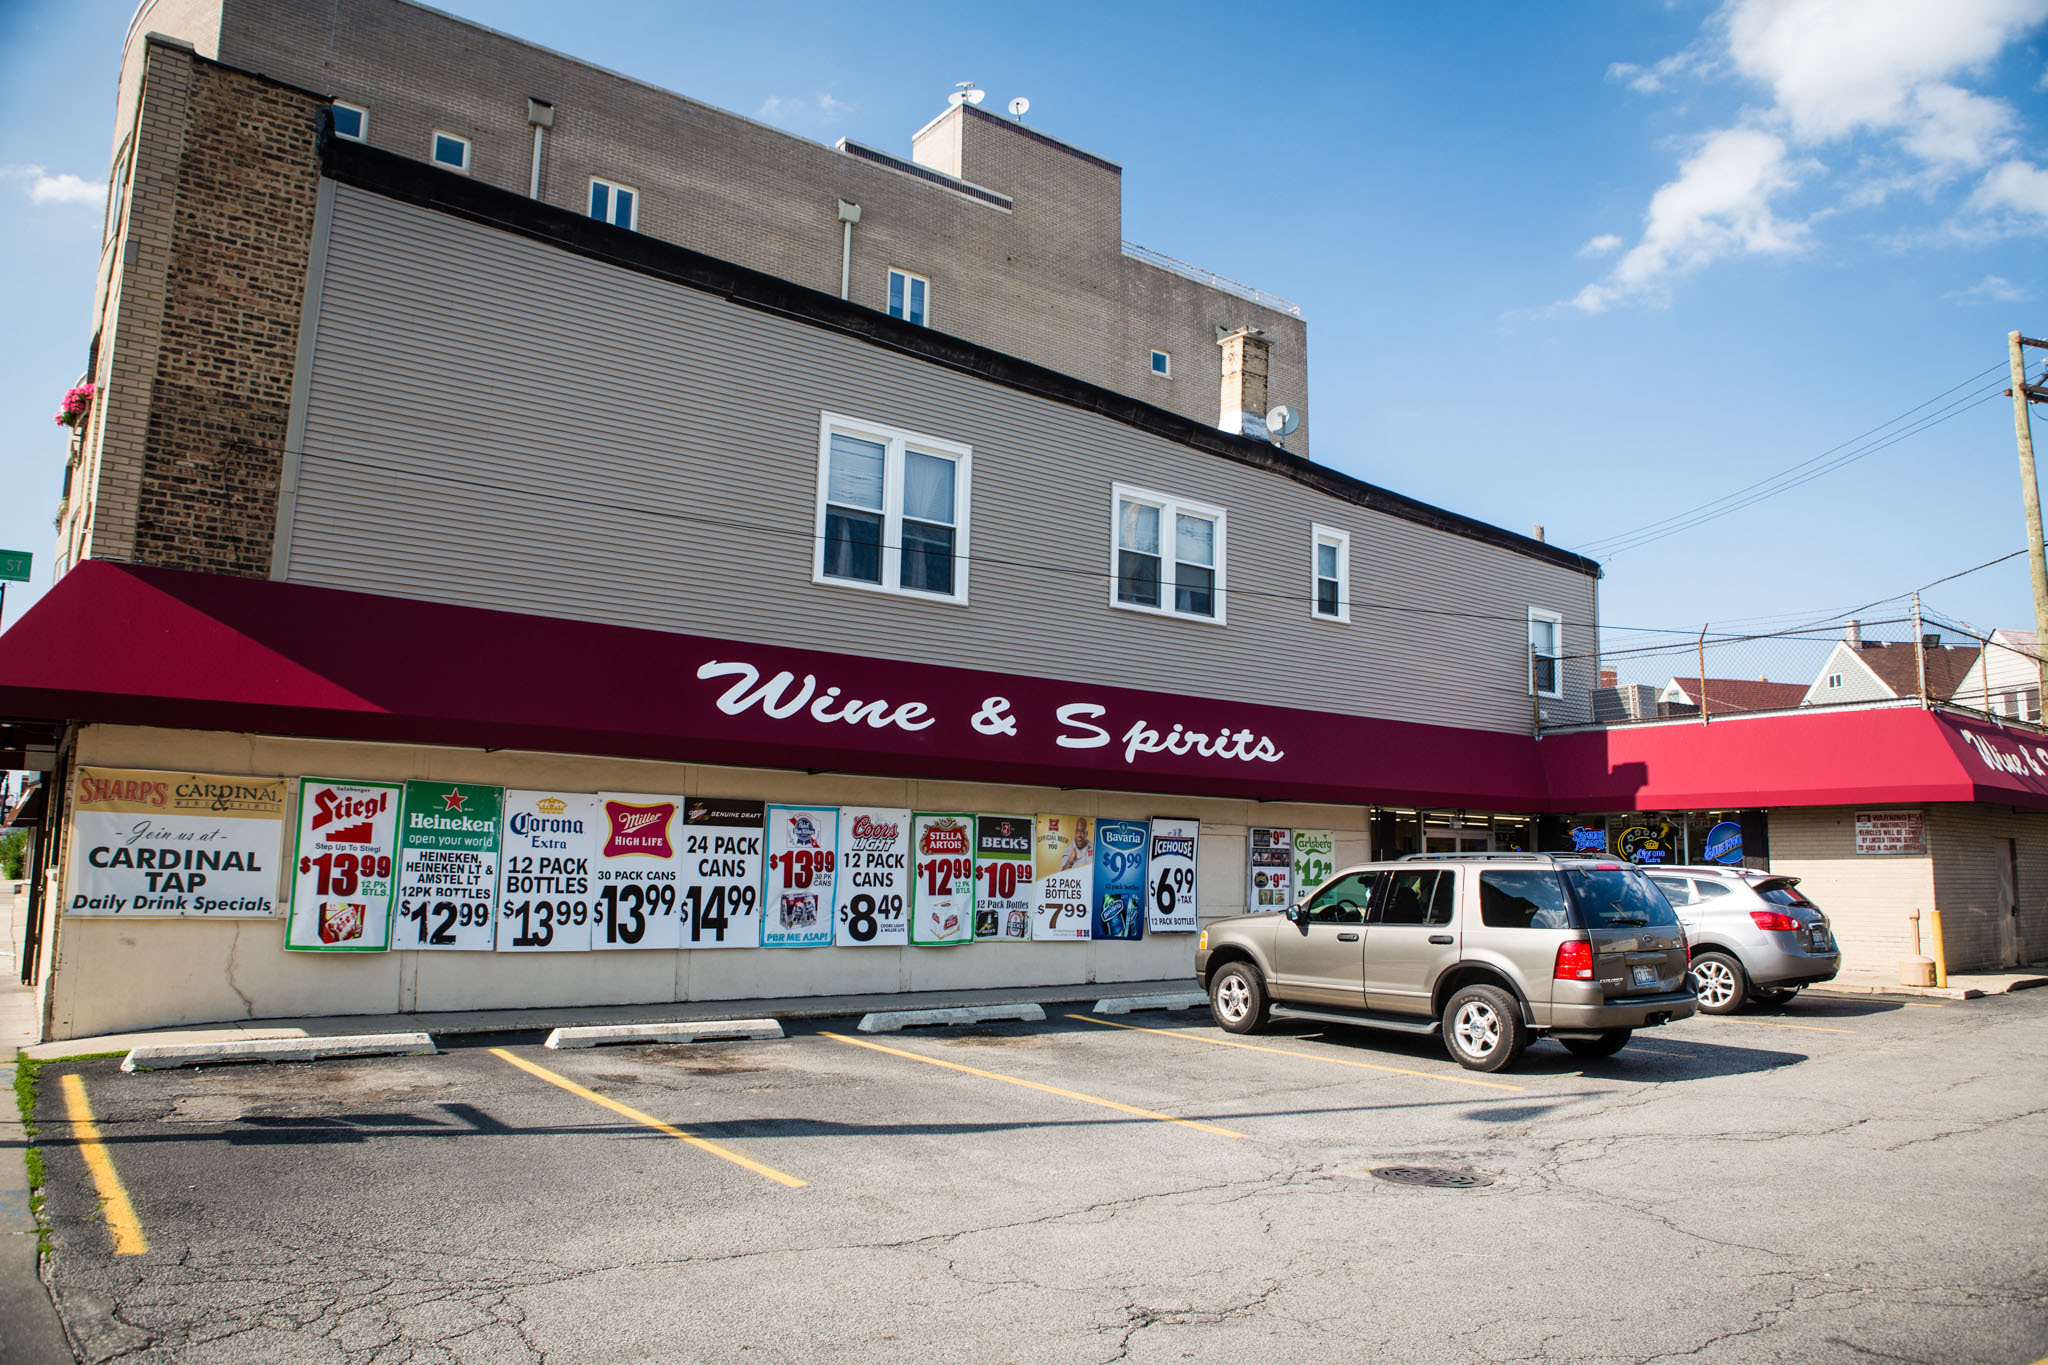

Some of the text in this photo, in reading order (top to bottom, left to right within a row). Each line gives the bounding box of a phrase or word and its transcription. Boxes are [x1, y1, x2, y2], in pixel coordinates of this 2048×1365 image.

[6, 559, 23, 573] ST
[697, 660, 936, 731] Wine
[970, 696, 1017, 735] &
[1960, 729, 2029, 776] Wine
[79, 777, 169, 807] SHARP'S
[175, 784, 282, 802] CARDINAL
[211, 793, 230, 811] &
[312, 788, 387, 830] Stiegl
[409, 812, 495, 833] Heineken
[510, 812, 584, 838] Corona
[618, 812, 663, 831] Miller
[852, 815, 899, 839] Coors
[126, 820, 220, 845] Join us at
[929, 832, 962, 840] STELLA
[1106, 831, 1141, 843] Bavaria
[408, 834, 493, 847] open your world
[531, 835, 567, 849] Extra
[687, 835, 760, 855] 24 PACK
[851, 838, 896, 852] LIGHT
[929, 841, 962, 849] ARTOIS
[981, 836, 1029, 849] BECK'S
[1294, 832, 1332, 852] Carlsberg
[315, 843, 333, 851] Step
[336, 844, 346, 852] Up
[359, 845, 381, 854] Stiegl
[1154, 839, 1193, 858] ICEHOUSE
[89, 846, 262, 872] CARDINAL
[419, 851, 482, 865] HEINEKEN,
[508, 856, 588, 875] 12 PACK
[844, 852, 905, 869] 12 PACK
[405, 862, 494, 875] HEINEKEN LT &
[698, 858, 746, 877] CANS
[145, 871, 207, 893] TAP
[417, 874, 481, 885] AMSTEL LT
[597, 870, 676, 881] 30 PACK CANS
[852, 871, 894, 887] CANS
[361, 880, 387, 889] 12 PK
[506, 875, 588, 894] BOTTLES
[1046, 878, 1082, 889] 12 PACK
[362, 889, 389, 897] BTLS.
[401, 886, 491, 899] 12PK BOTTLES
[1045, 889, 1082, 899] BOTTLES
[1297, 889, 1306, 898] 12
[72, 894, 272, 914] Daily Drink Specials
[976, 900, 1029, 909] 12 Pack Bottles
[1151, 917, 1195, 926] 12 PACK BOTTLES
[767, 932, 828, 942] PBR ME ASAP!
